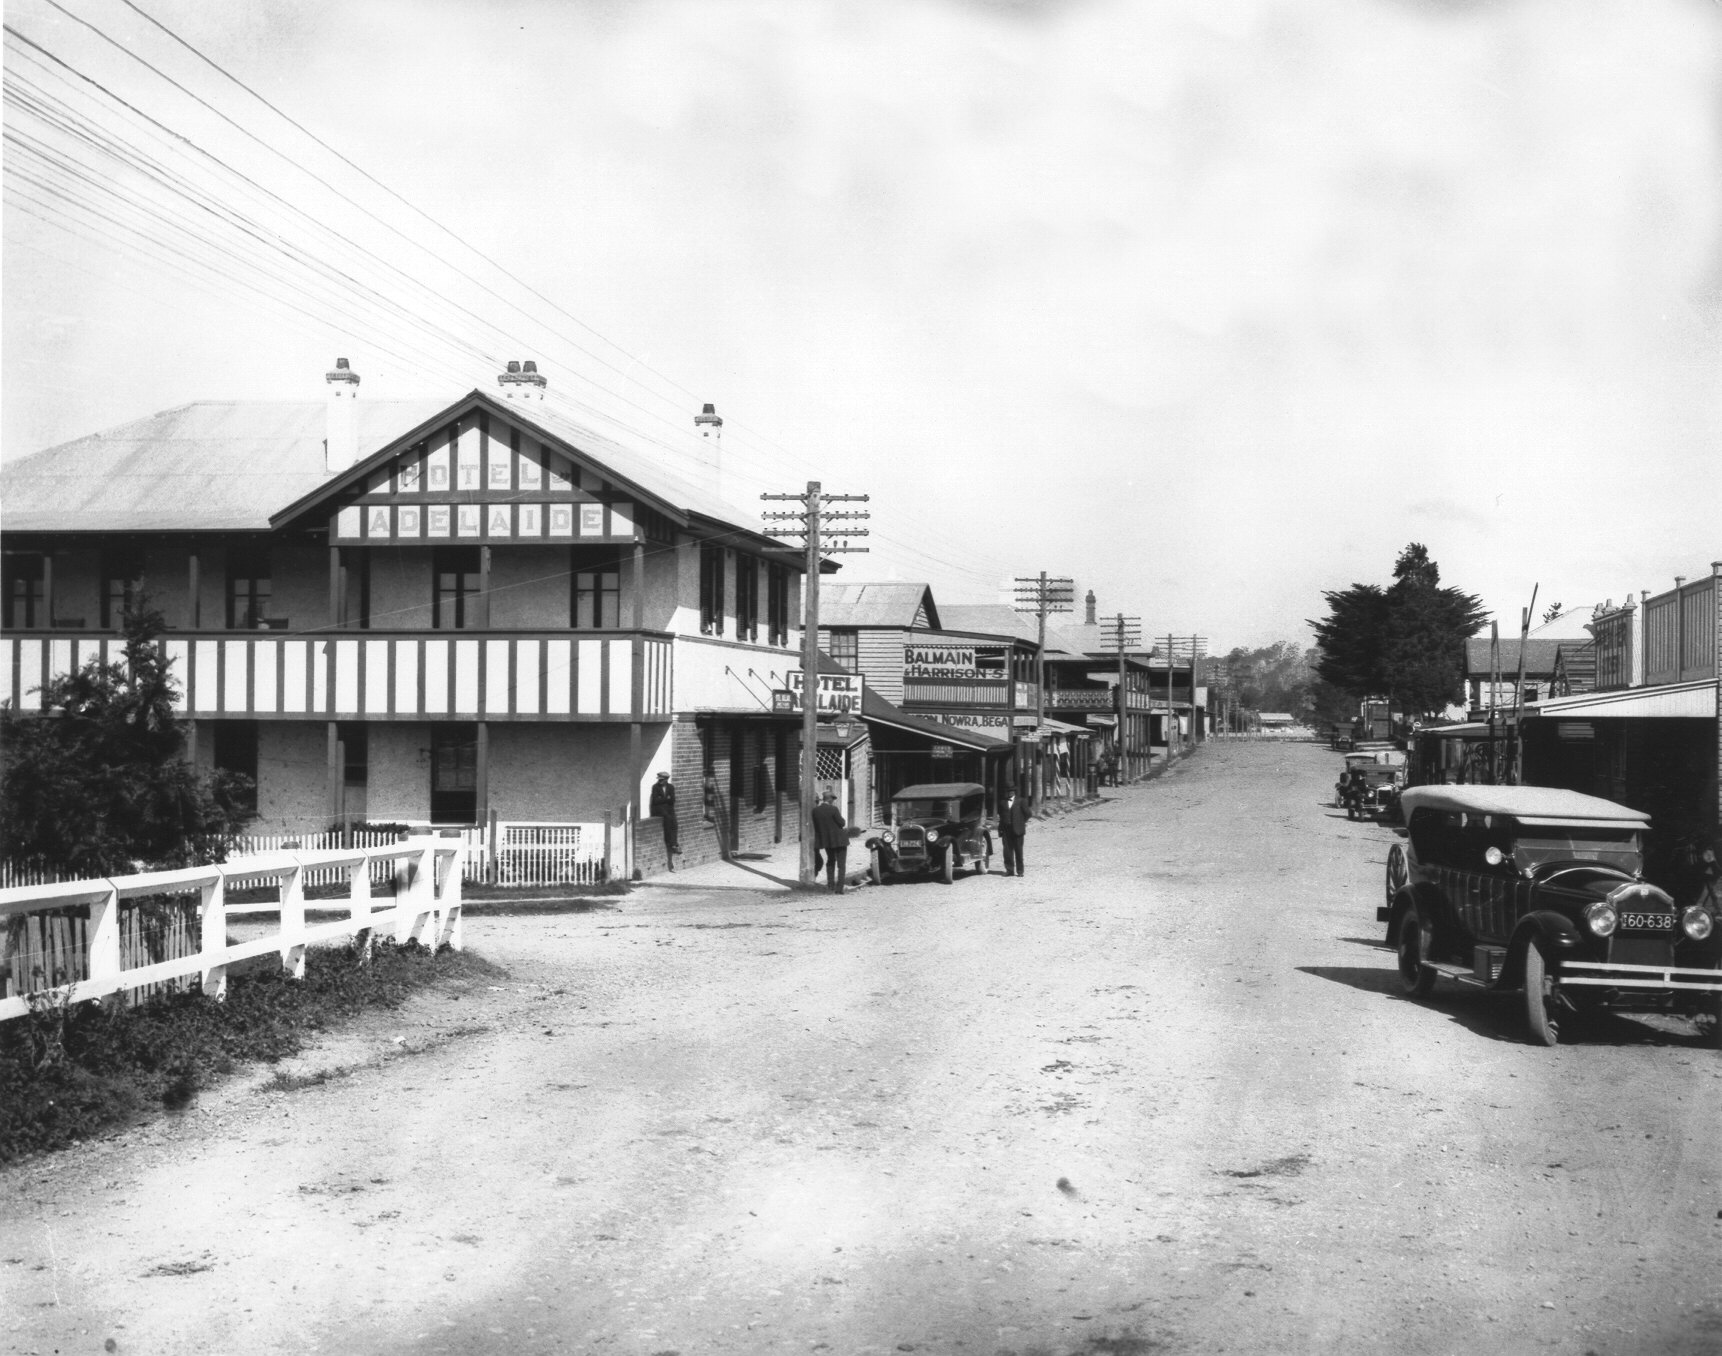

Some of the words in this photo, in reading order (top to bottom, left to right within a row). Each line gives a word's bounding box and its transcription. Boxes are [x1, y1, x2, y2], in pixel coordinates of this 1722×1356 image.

[399, 463, 540, 485] HOTEL
[370, 510, 602, 532] ADELAIDE
[904, 648, 973, 666] BALMAIN
[793, 674, 858, 692] HTEL
[982, 716, 1008, 728] BEGA
